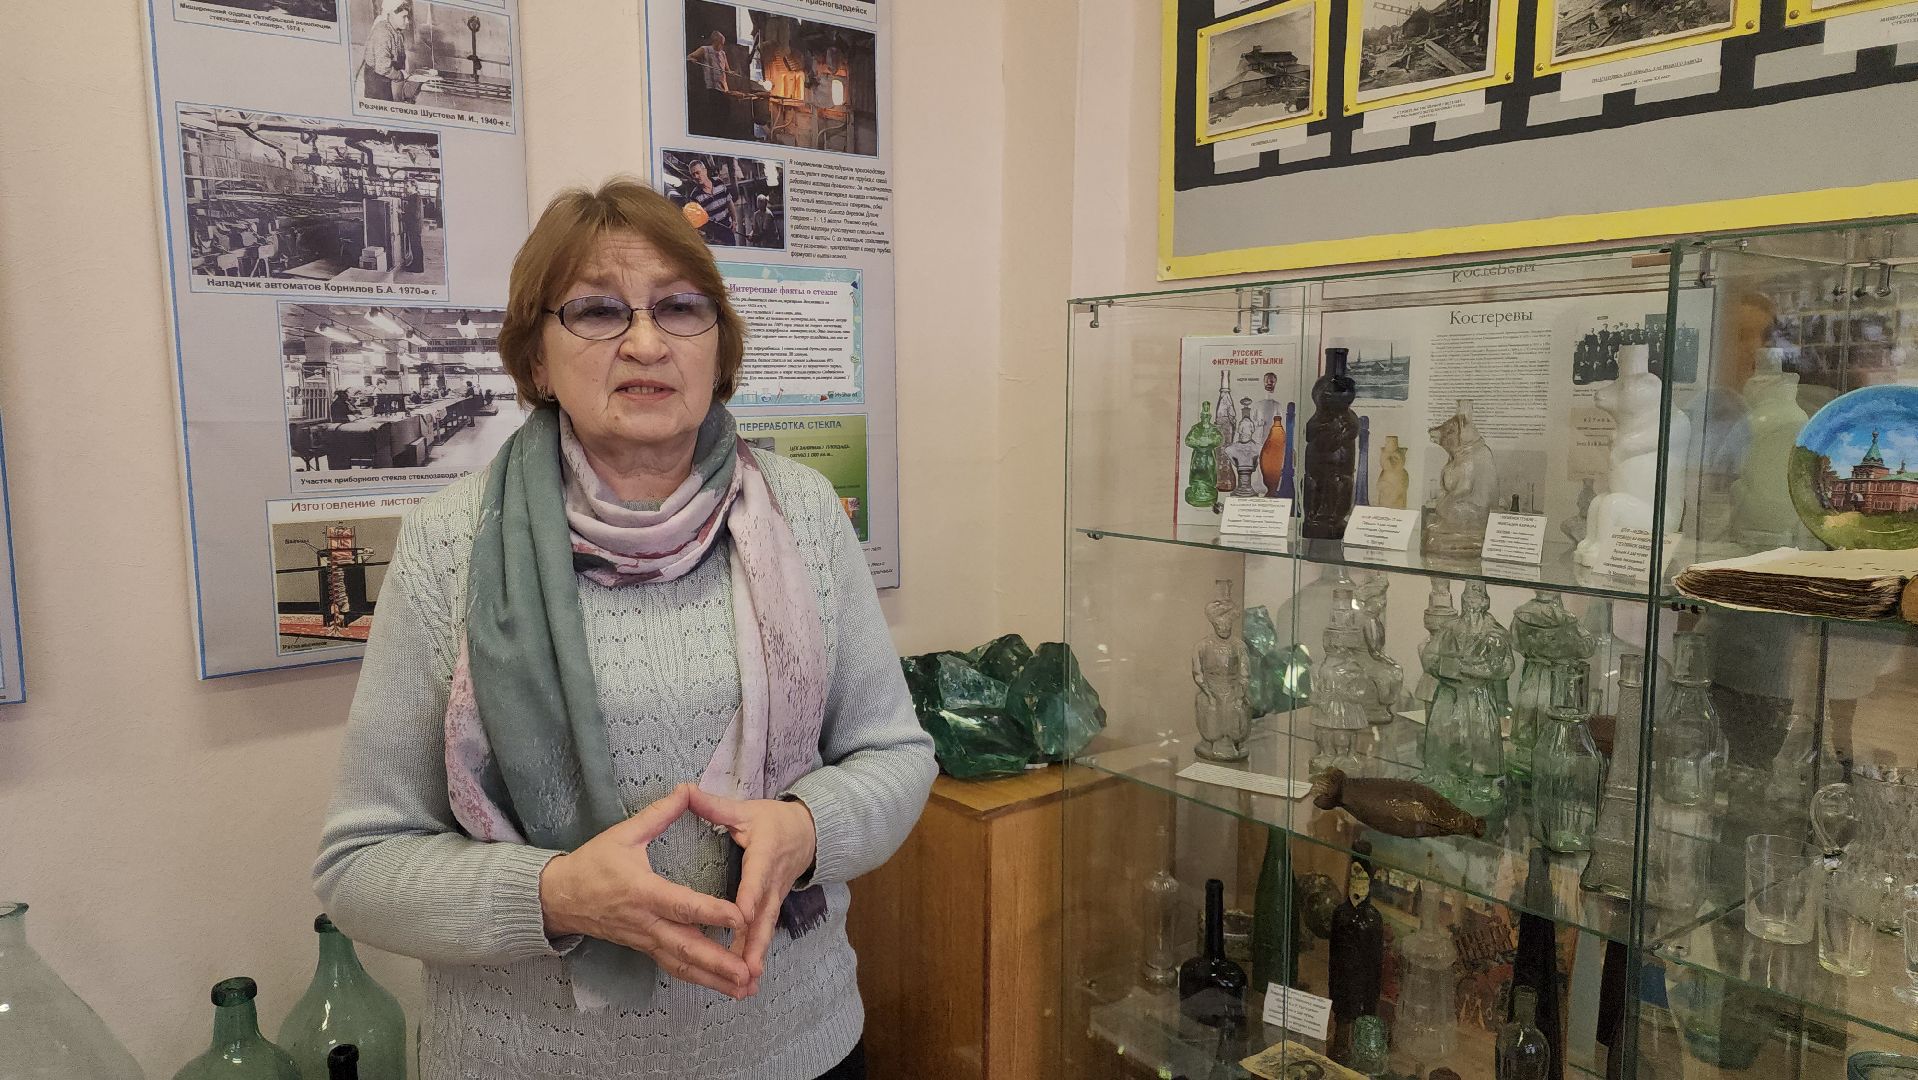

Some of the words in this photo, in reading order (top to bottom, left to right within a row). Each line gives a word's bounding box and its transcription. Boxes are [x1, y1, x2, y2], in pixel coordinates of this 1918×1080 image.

[390, 106, 419, 116] стекла
[206, 278, 262, 290] Наладчик
[264, 281, 322, 291] автоматов
[324, 282, 374, 294] Корнилов
[376, 284, 397, 294] Б.А.
[729, 283, 778, 294] Интересные
[779, 285, 805, 296] факты
[1449, 310, 1533, 328] Костеревы
[1232, 349, 1263, 357] РУССКИЕ
[1212, 357, 1248, 366] ФИГУРНЫЕ
[1250, 357, 1284, 365] БУТЫЛКИ
[739, 421, 805, 432] ПЕРЕРАБОТКА
[807, 420, 842, 430] СТЕКЛА
[300, 477, 333, 486] Участок
[333, 475, 380, 485] приборного
[381, 474, 407, 482] стекла
[408, 472, 458, 480] стеклозавода
[291, 499, 376, 513] Изготовление
